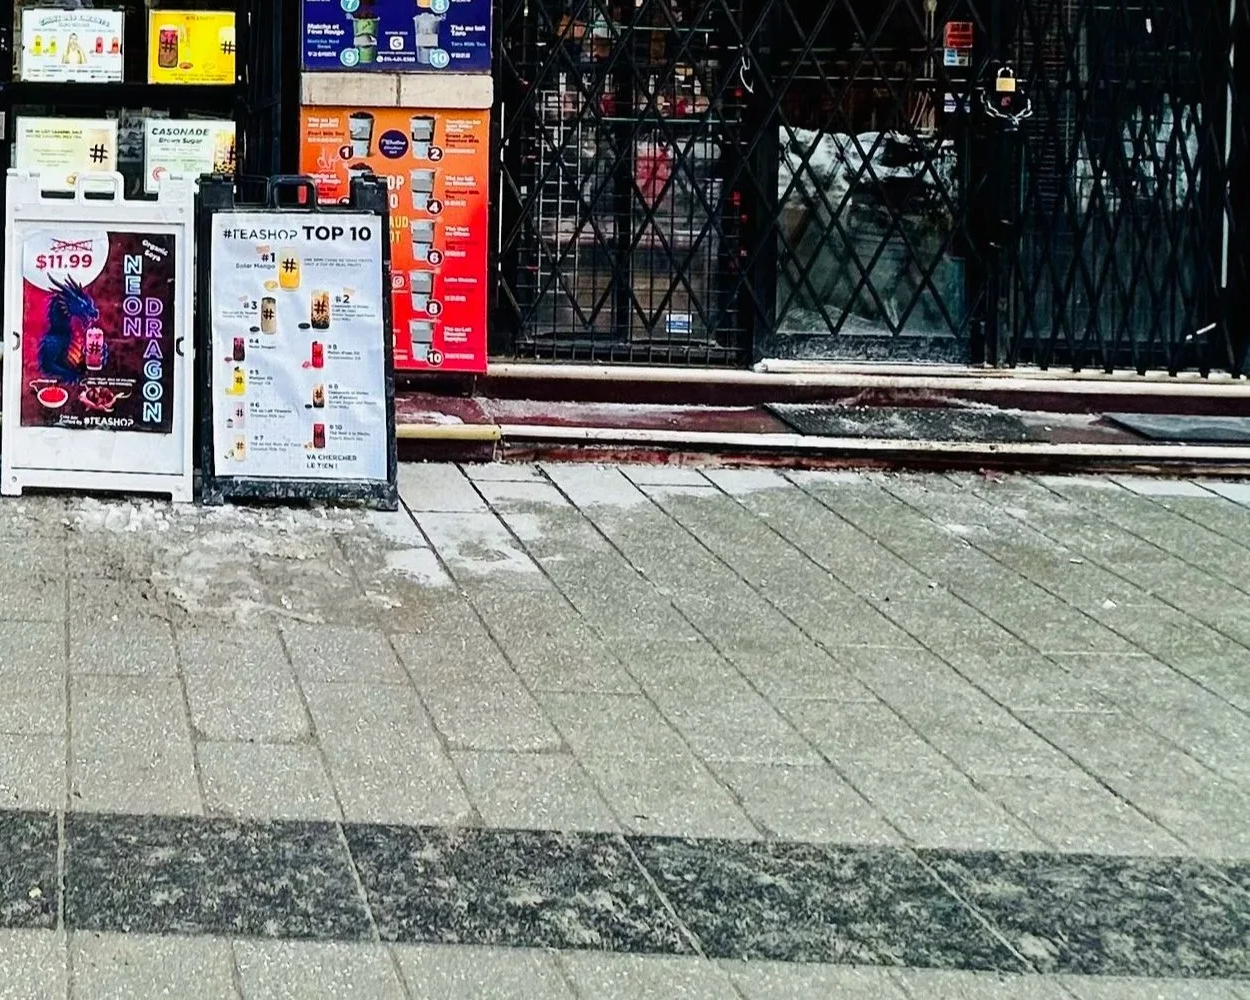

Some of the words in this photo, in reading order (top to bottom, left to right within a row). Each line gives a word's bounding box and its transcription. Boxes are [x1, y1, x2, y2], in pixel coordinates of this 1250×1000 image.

[344, 51, 354, 62] 9
[432, 52, 445, 64] 10
[342, 147, 349, 158] 1
[430, 148, 440, 160] 2
[387, 175, 405, 190] OP
[429, 201, 439, 213] 4
[389, 215, 409, 228] AUD
[223, 228, 298, 241] #TEASHOP
[302, 226, 344, 241] TOP
[350, 226, 372, 241] 10
[389, 231, 401, 243] OT
[141, 239, 169, 257] Organic
[35, 253, 93, 270] $11.99
[429, 252, 439, 264] 6
[123, 254, 143, 337] NEON
[428, 303, 438, 314] 8
[142, 296, 164, 423] DRAGON
[427, 353, 442, 363] 10
